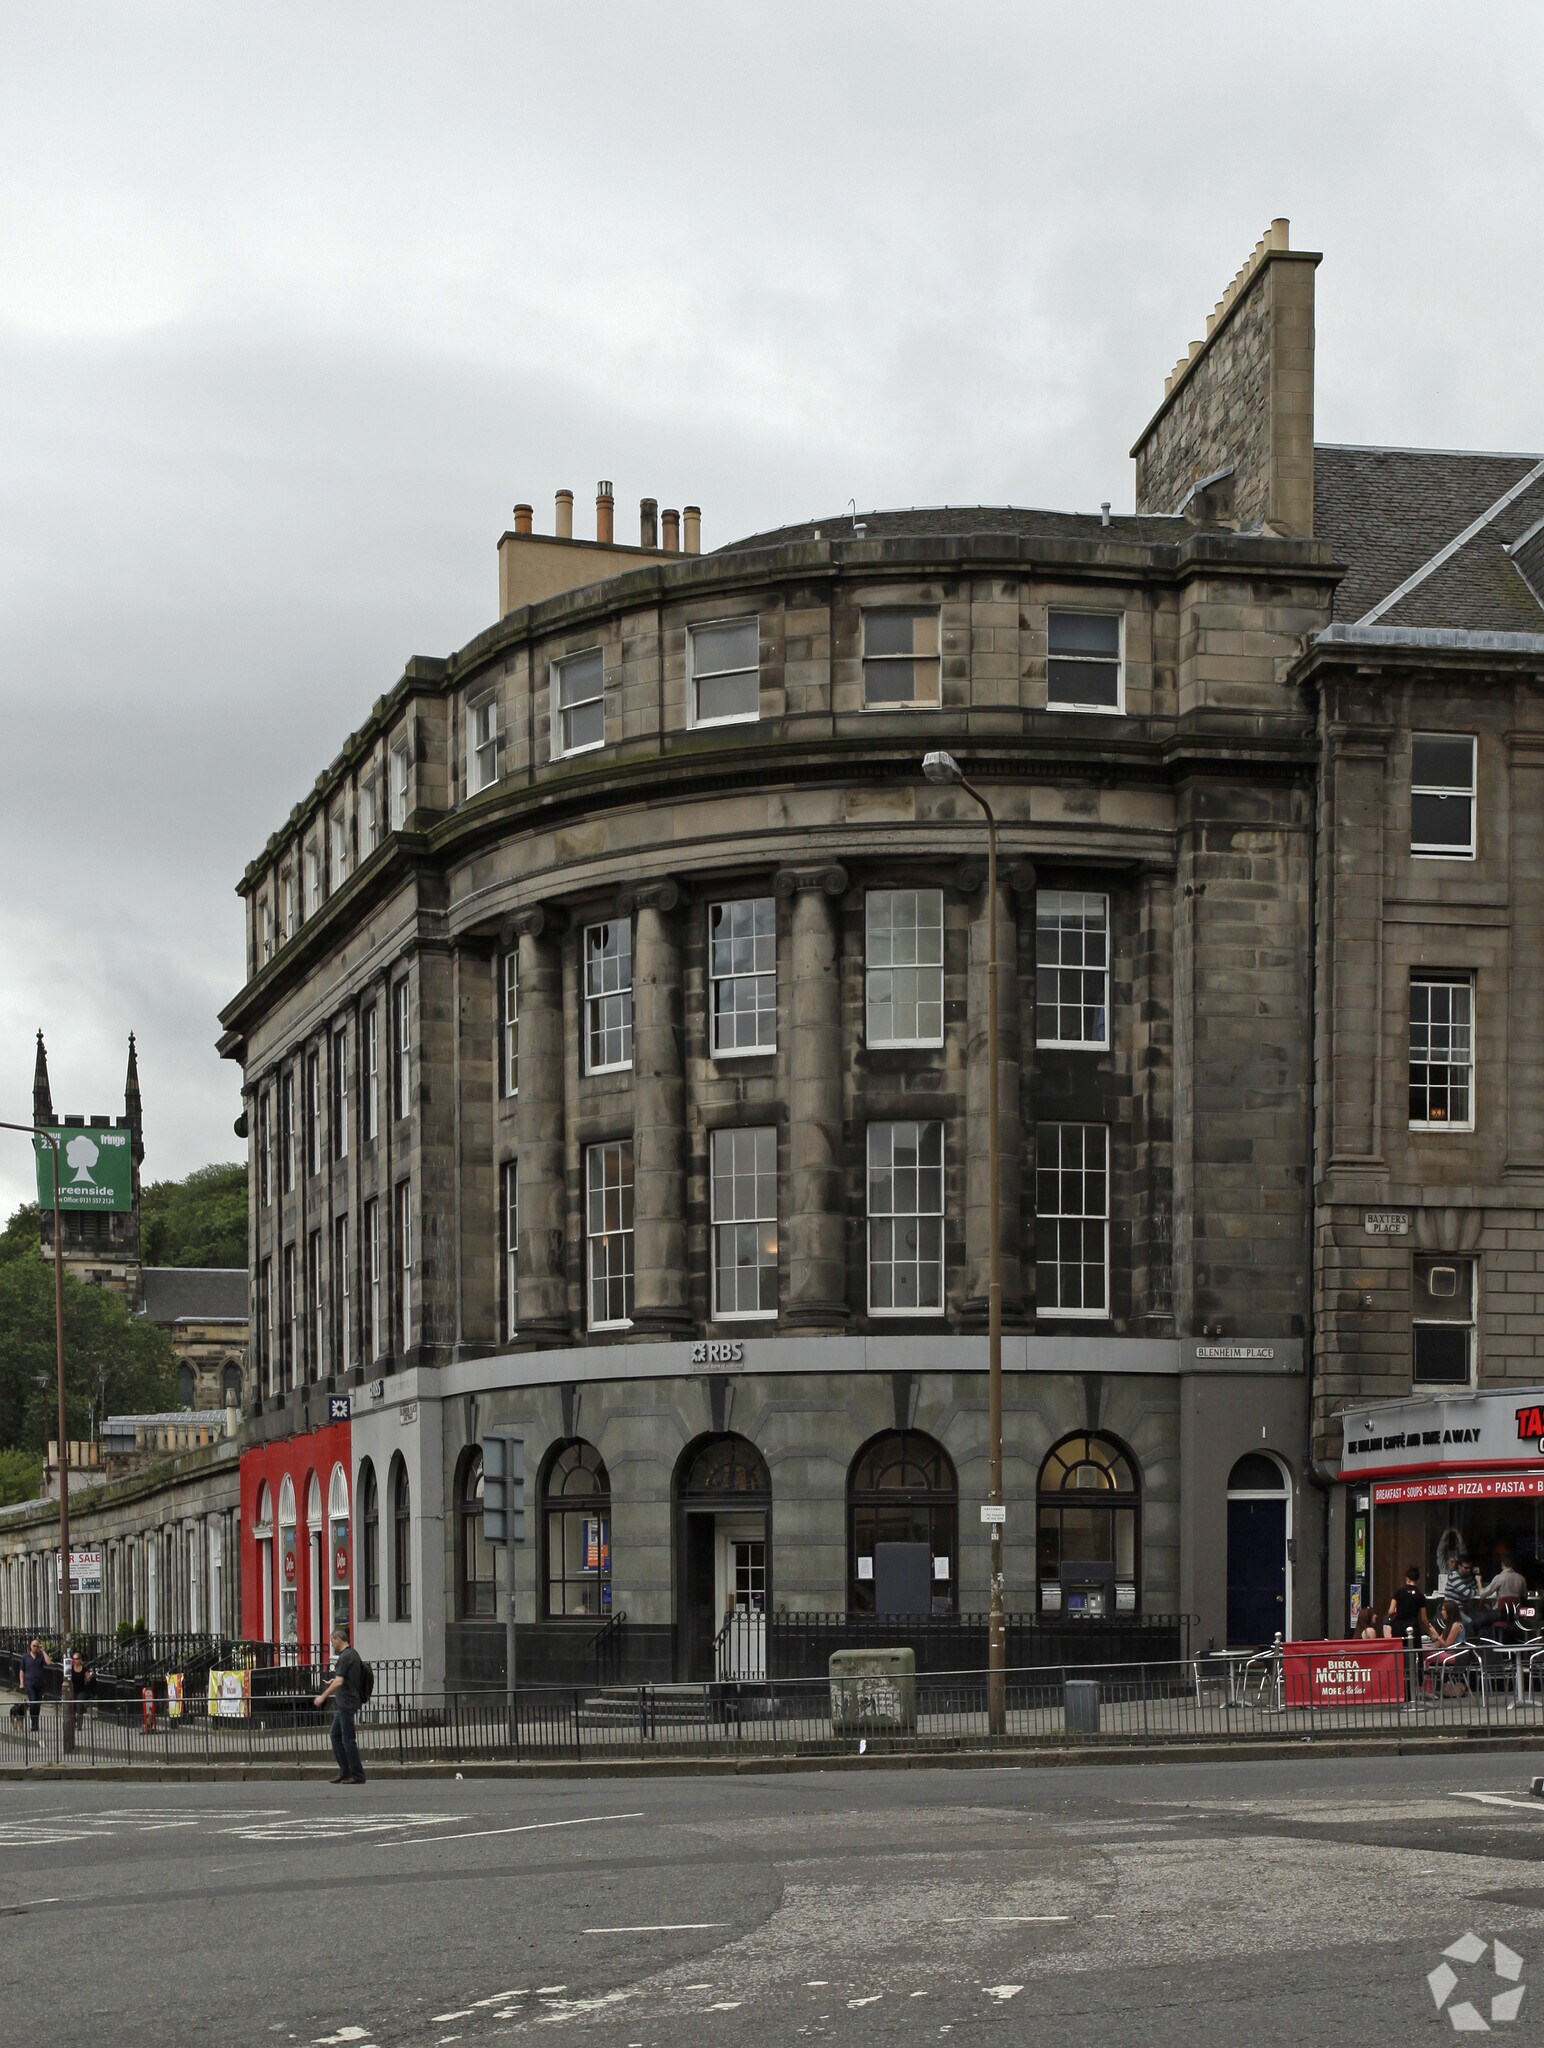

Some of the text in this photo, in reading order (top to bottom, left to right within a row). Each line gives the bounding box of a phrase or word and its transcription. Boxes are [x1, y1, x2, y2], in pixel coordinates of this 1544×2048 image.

[100, 1134, 126, 1147] fringe
[57, 1187, 114, 1196] reenside
[1373, 1223, 1401, 1233] PLACE
[708, 1342, 743, 1362] RBS
[1198, 1348, 1273, 1357] BLENHEIM PLACE
[1516, 1405, 1544, 1439] TA
[1375, 1488, 1402, 1500] BREAKFAST
[1406, 1486, 1423, 1498] SOUPS
[1427, 1484, 1447, 1496] SALADS
[1457, 1483, 1484, 1494] PIZZA
[1495, 1481, 1526, 1493] PASTA
[57, 1553, 101, 1564] FR SALE
[1328, 1661, 1359, 1669] BIRRA
[1316, 1667, 1371, 1683] MORETTI
